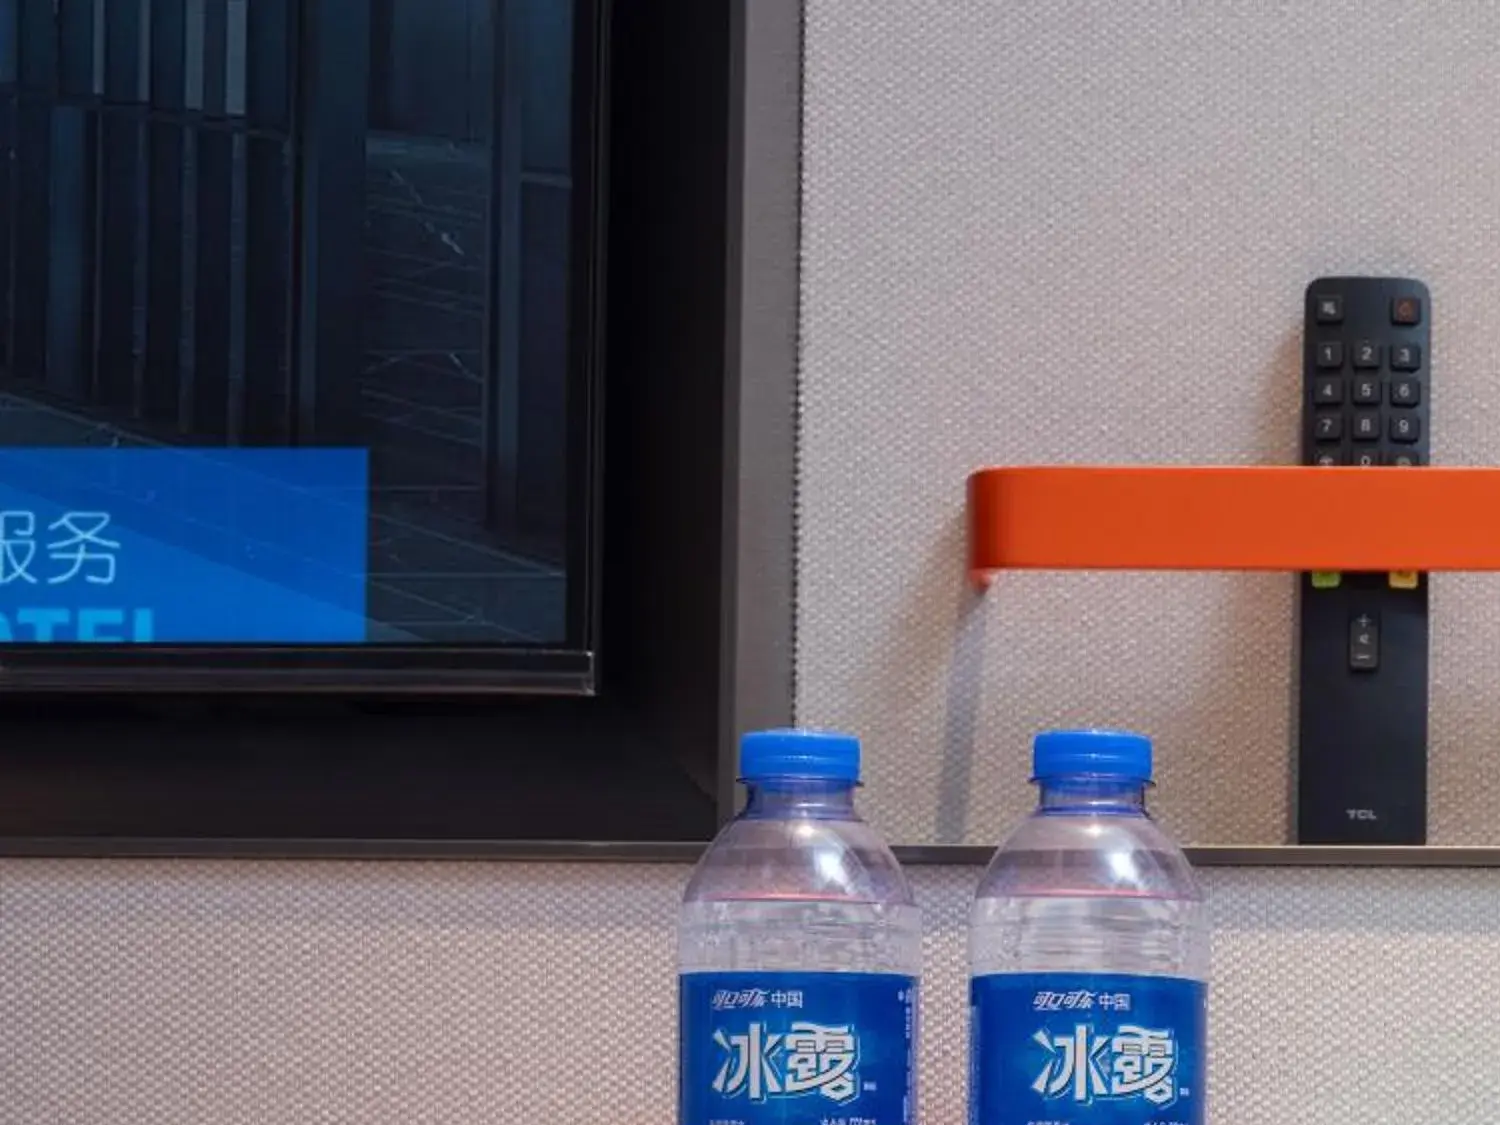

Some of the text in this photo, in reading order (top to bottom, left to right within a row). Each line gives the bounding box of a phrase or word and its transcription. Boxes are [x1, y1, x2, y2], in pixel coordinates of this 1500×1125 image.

[1324, 346, 1410, 362] 1 2 3
[1322, 383, 1410, 397] 4 5 6
[1322, 419, 1409, 433] 7 8 9
[1345, 808, 1377, 820] TCL
[711, 1020, 860, 1105] 冰露
[1031, 1022, 1177, 1108] 冰露
